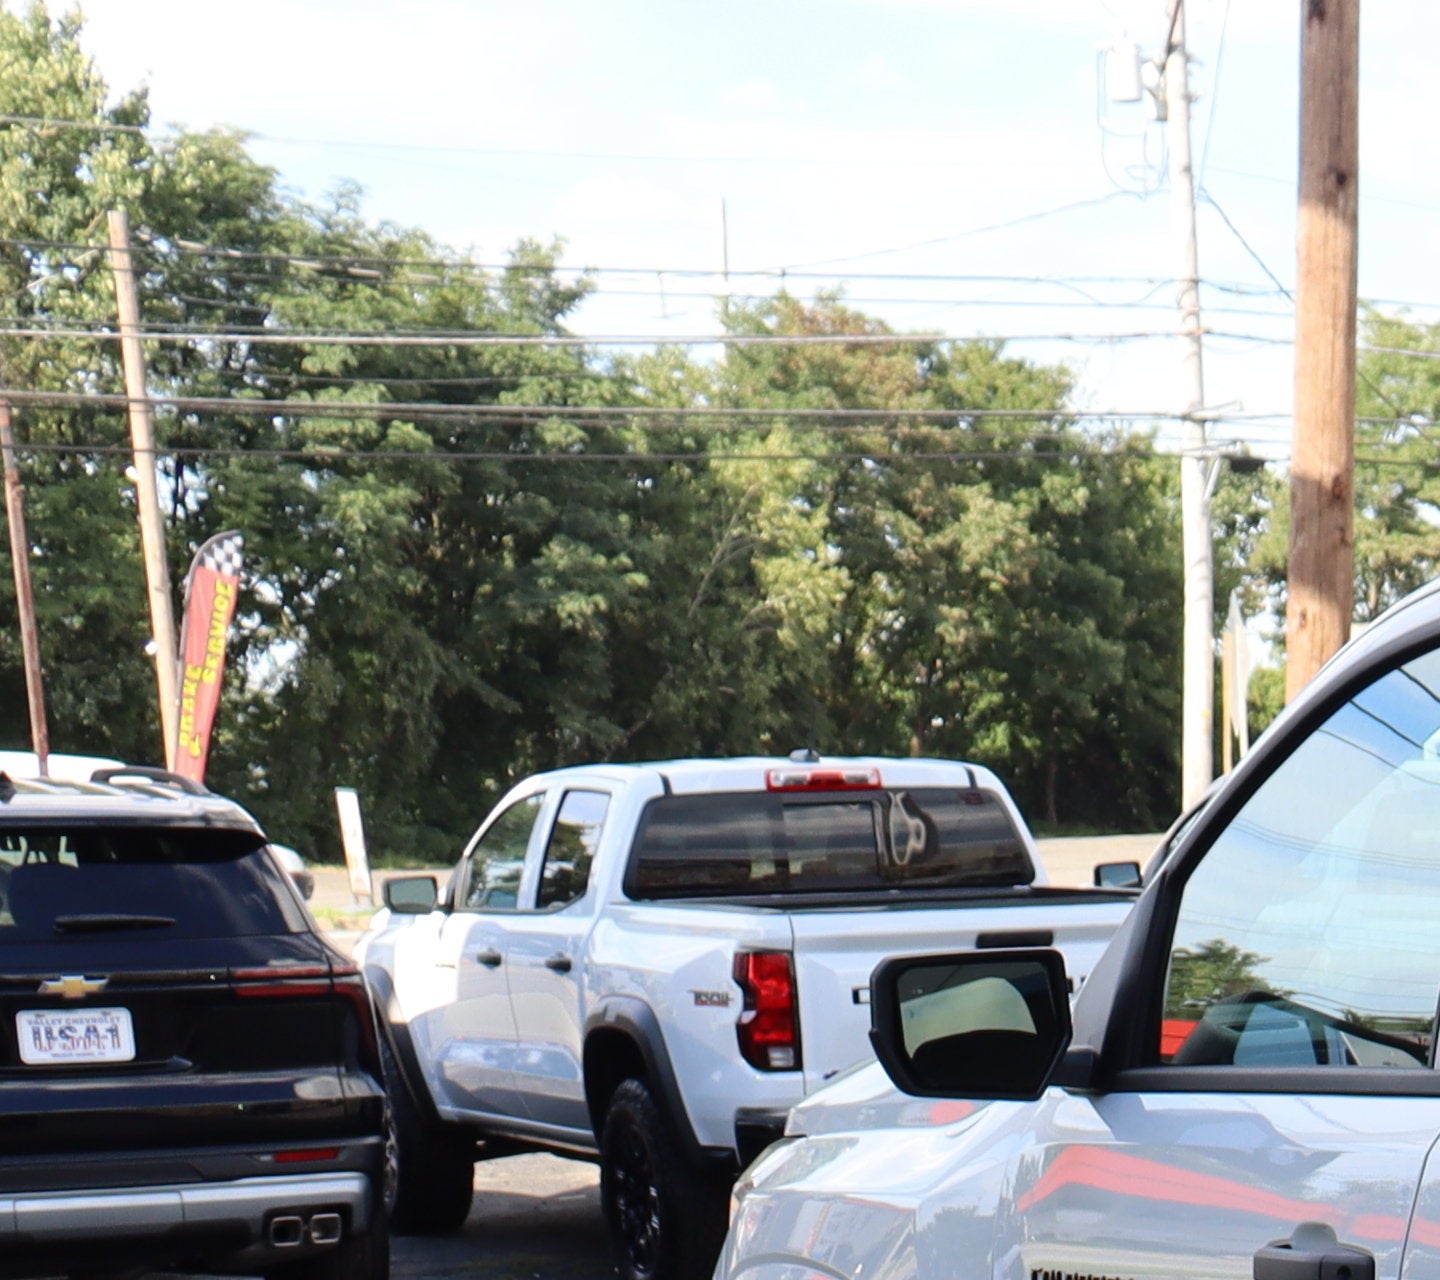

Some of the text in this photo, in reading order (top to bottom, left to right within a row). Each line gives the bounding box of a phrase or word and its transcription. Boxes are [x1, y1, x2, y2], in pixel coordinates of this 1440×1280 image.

[201, 579, 233, 684] SERVICE
[27, 1016, 121, 1026] VALLEY CHEVROLET
